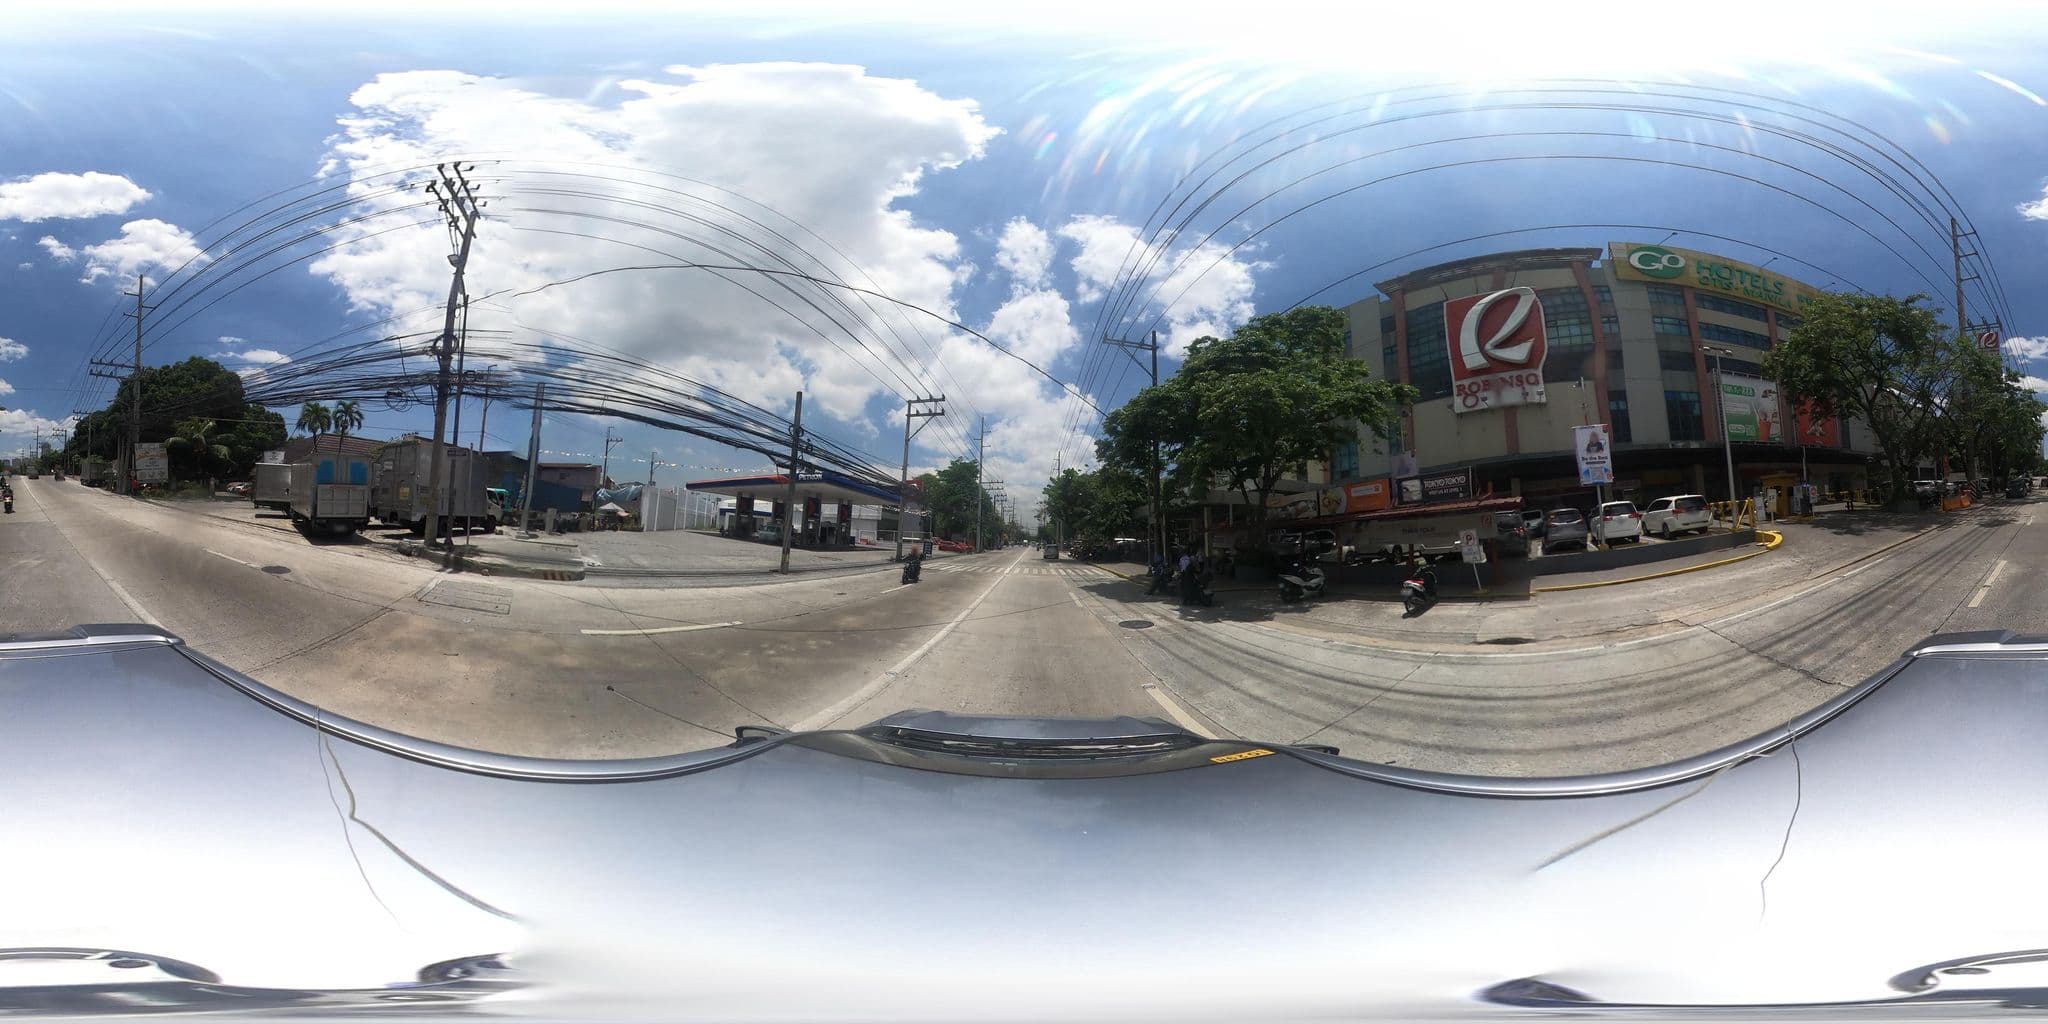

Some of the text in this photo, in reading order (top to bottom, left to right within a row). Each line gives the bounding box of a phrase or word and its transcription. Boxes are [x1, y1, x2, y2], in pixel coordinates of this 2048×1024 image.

[1629, 251, 1687, 271] GO
[1696, 260, 1785, 295] HOTELS
[798, 473, 823, 481] PETRON
